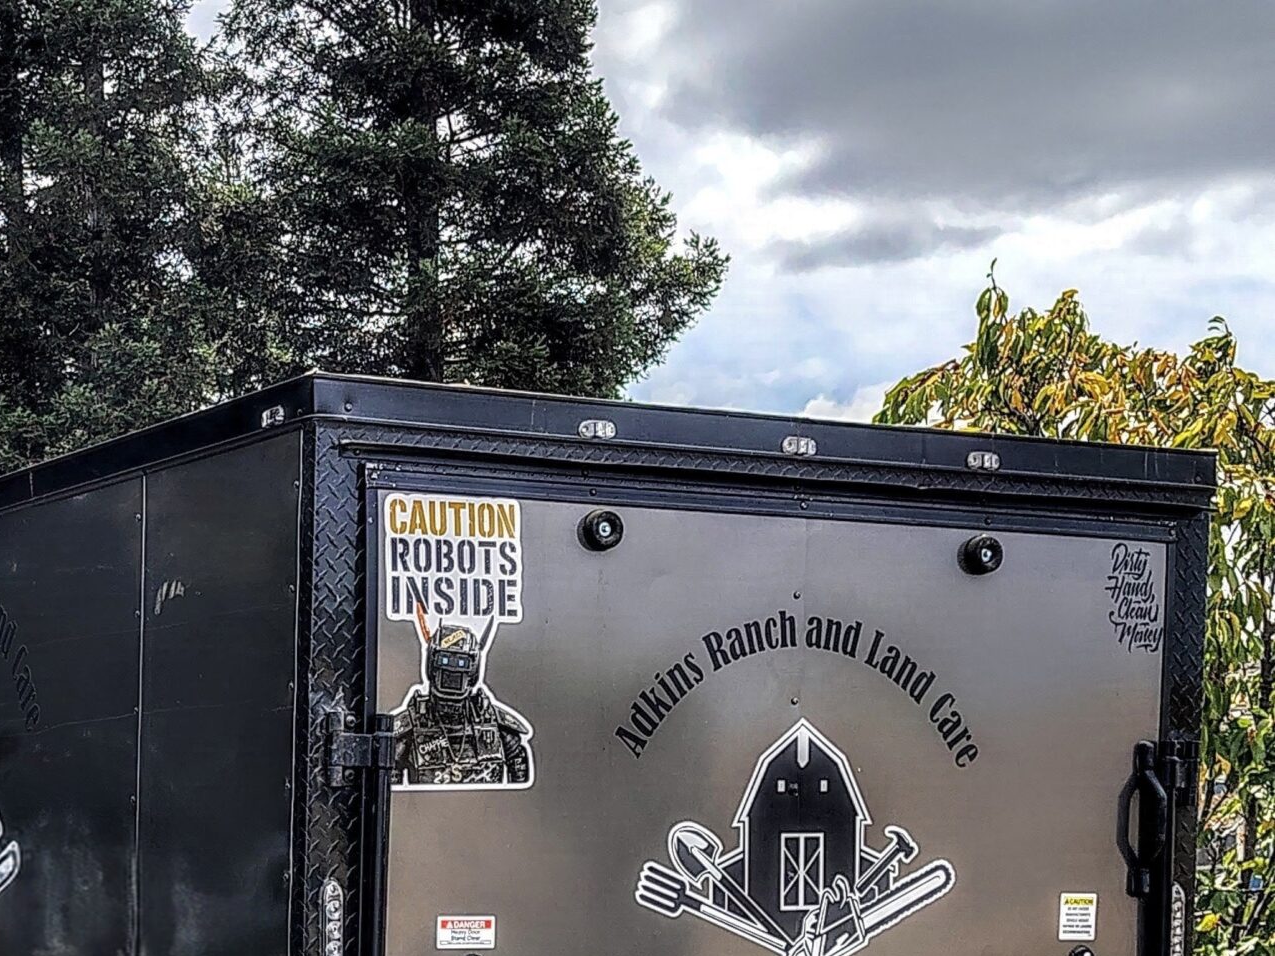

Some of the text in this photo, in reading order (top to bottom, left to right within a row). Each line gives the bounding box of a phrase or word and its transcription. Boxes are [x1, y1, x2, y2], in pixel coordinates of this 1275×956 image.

[389, 498, 516, 538] CAUTION
[390, 537, 518, 576] ROBOTS
[1111, 542, 1150, 580] Dirty
[390, 576, 518, 617] INSIDE
[1117, 597, 1159, 622] Clean
[1109, 611, 1163, 654] Money
[614, 610, 979, 769] Adkins Ranch and Land Care
[453, 920, 486, 929] DANGER
